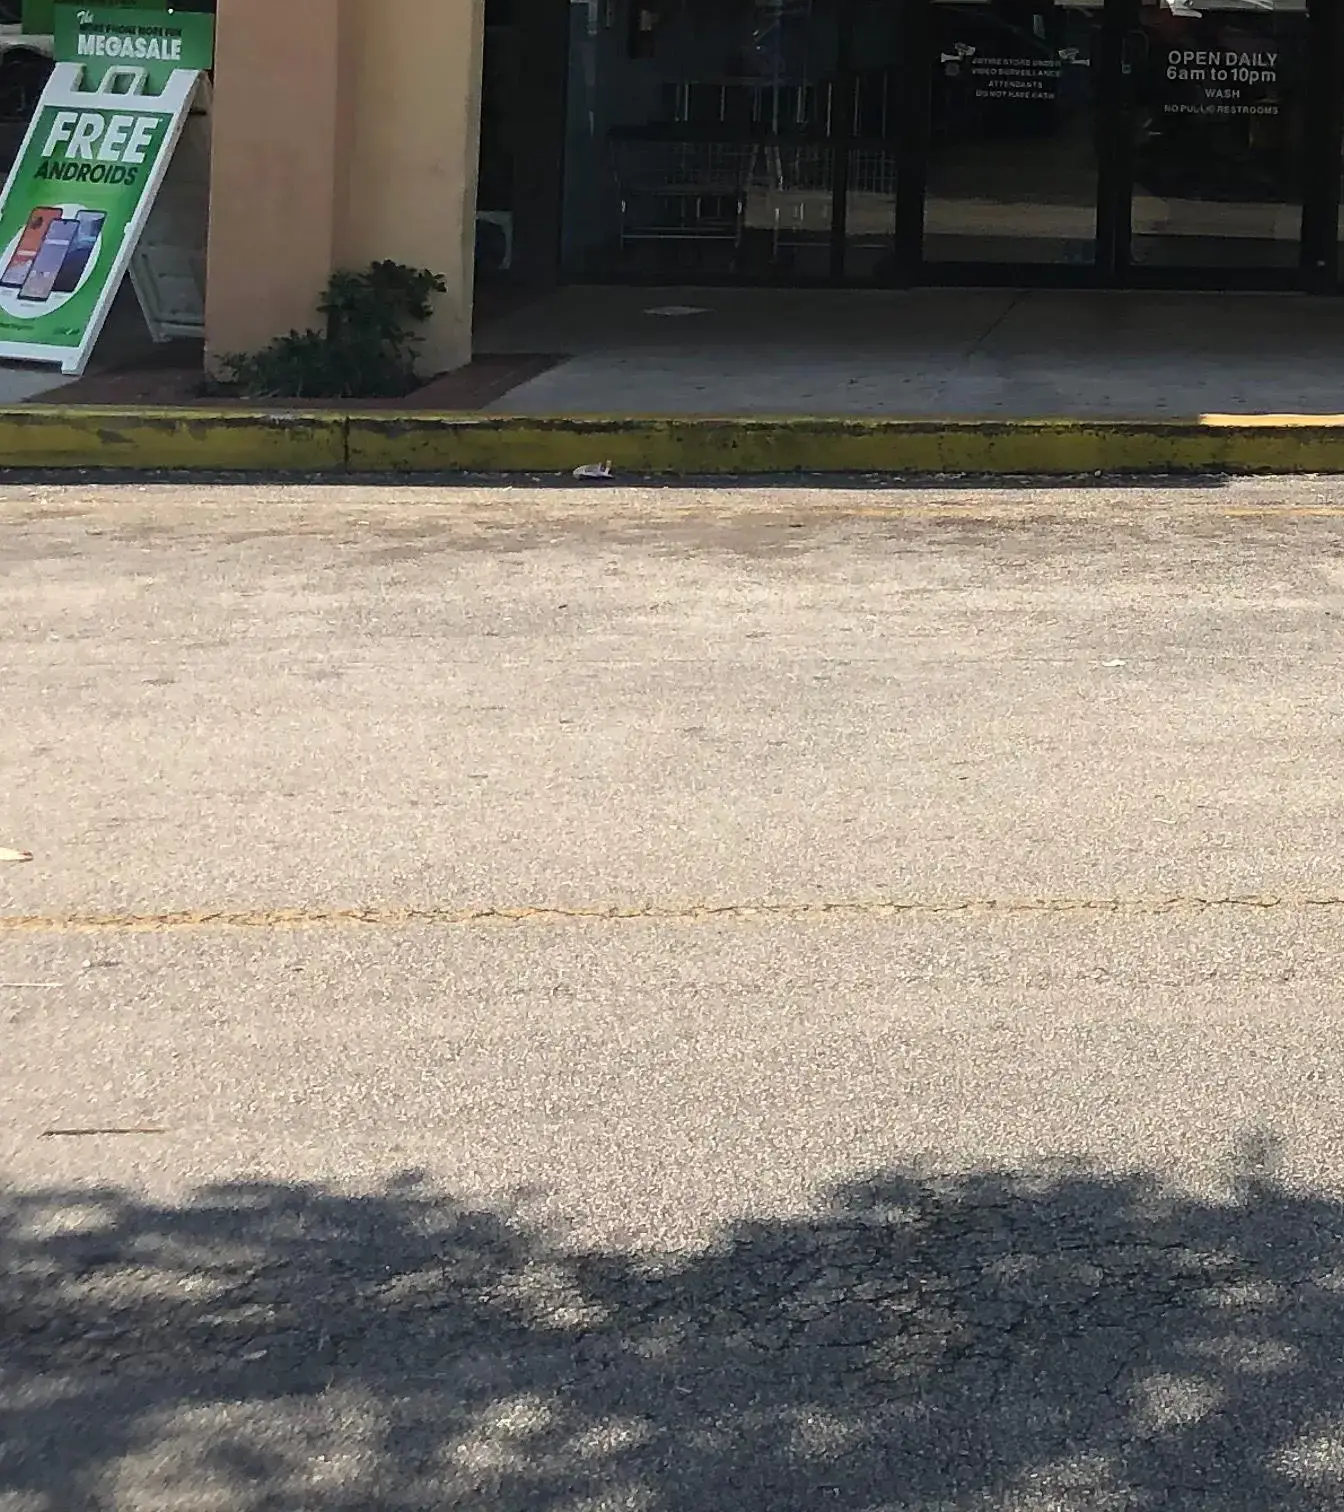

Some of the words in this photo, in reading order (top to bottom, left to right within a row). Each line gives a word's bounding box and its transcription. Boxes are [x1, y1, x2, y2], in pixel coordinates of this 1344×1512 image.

[77, 33, 182, 61] MEGASALE
[1168, 50, 1221, 65] OPEN
[1225, 52, 1278, 67] DAILY
[1166, 66, 1205, 80] 6am
[1210, 67, 1228, 81] to
[1230, 67, 1276, 85] 10pm
[1204, 88, 1241, 99] WASH
[1164, 104, 1179, 113] NO
[1216, 105, 1279, 115] RESTROOMS
[41, 110, 160, 165] FREE
[34, 160, 138, 186] ANDROIDS
